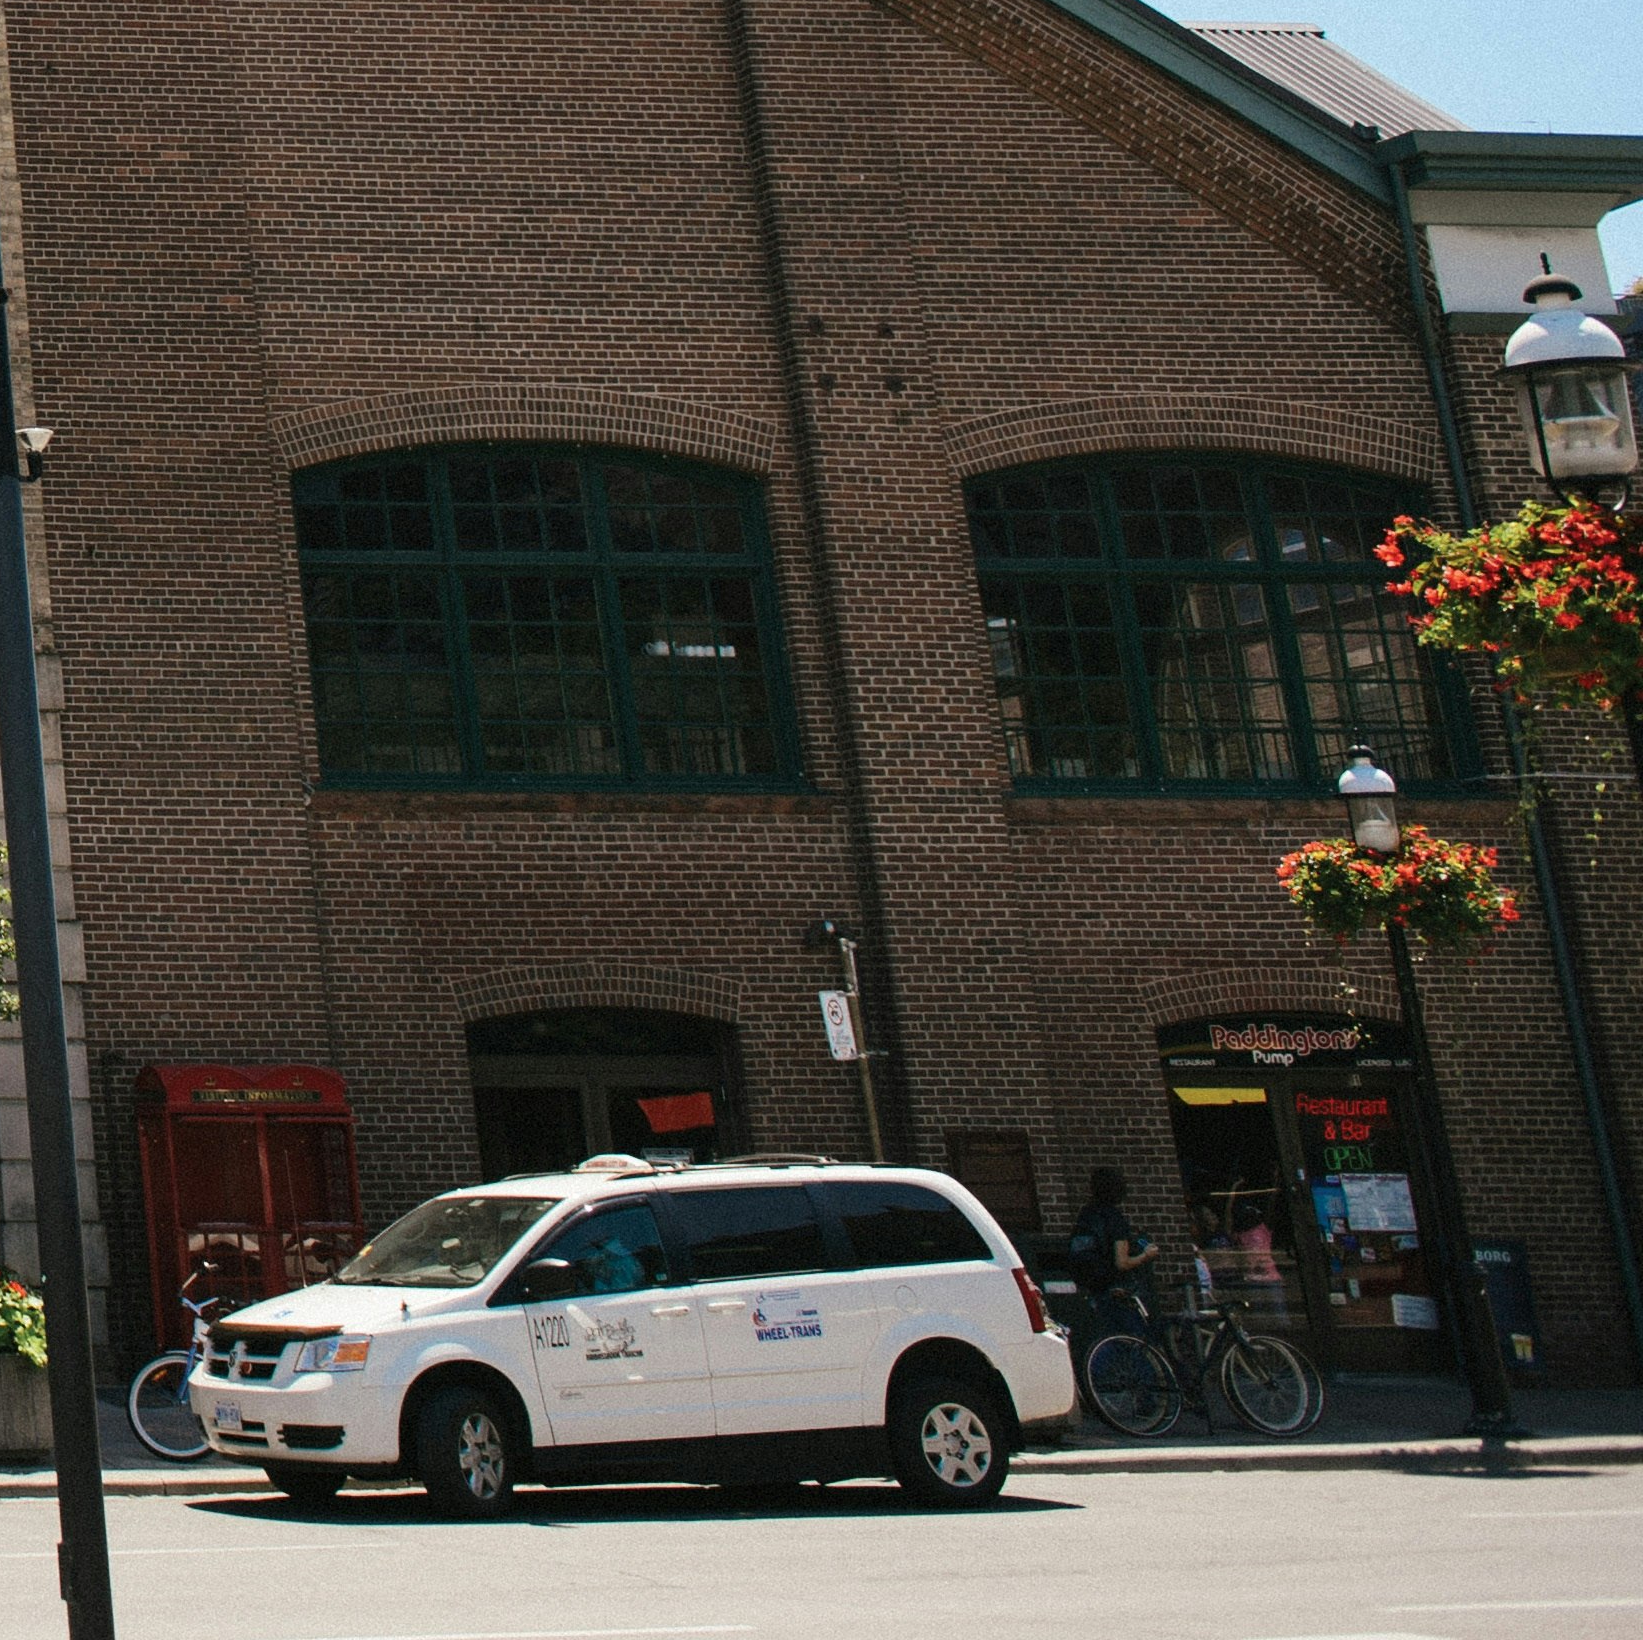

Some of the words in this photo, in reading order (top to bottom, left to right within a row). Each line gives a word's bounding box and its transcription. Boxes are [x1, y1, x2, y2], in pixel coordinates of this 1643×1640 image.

[1252, 1050, 1294, 1067] Pump
[1295, 1093, 1388, 1116] Restaurant
[1324, 1120, 1336, 1141] &
[1341, 1120, 1372, 1141] Bar
[1324, 1146, 1373, 1170] OPEN
[533, 1315, 570, 1350] A1220
[755, 1324, 822, 1341] WHEEL-TRANS
